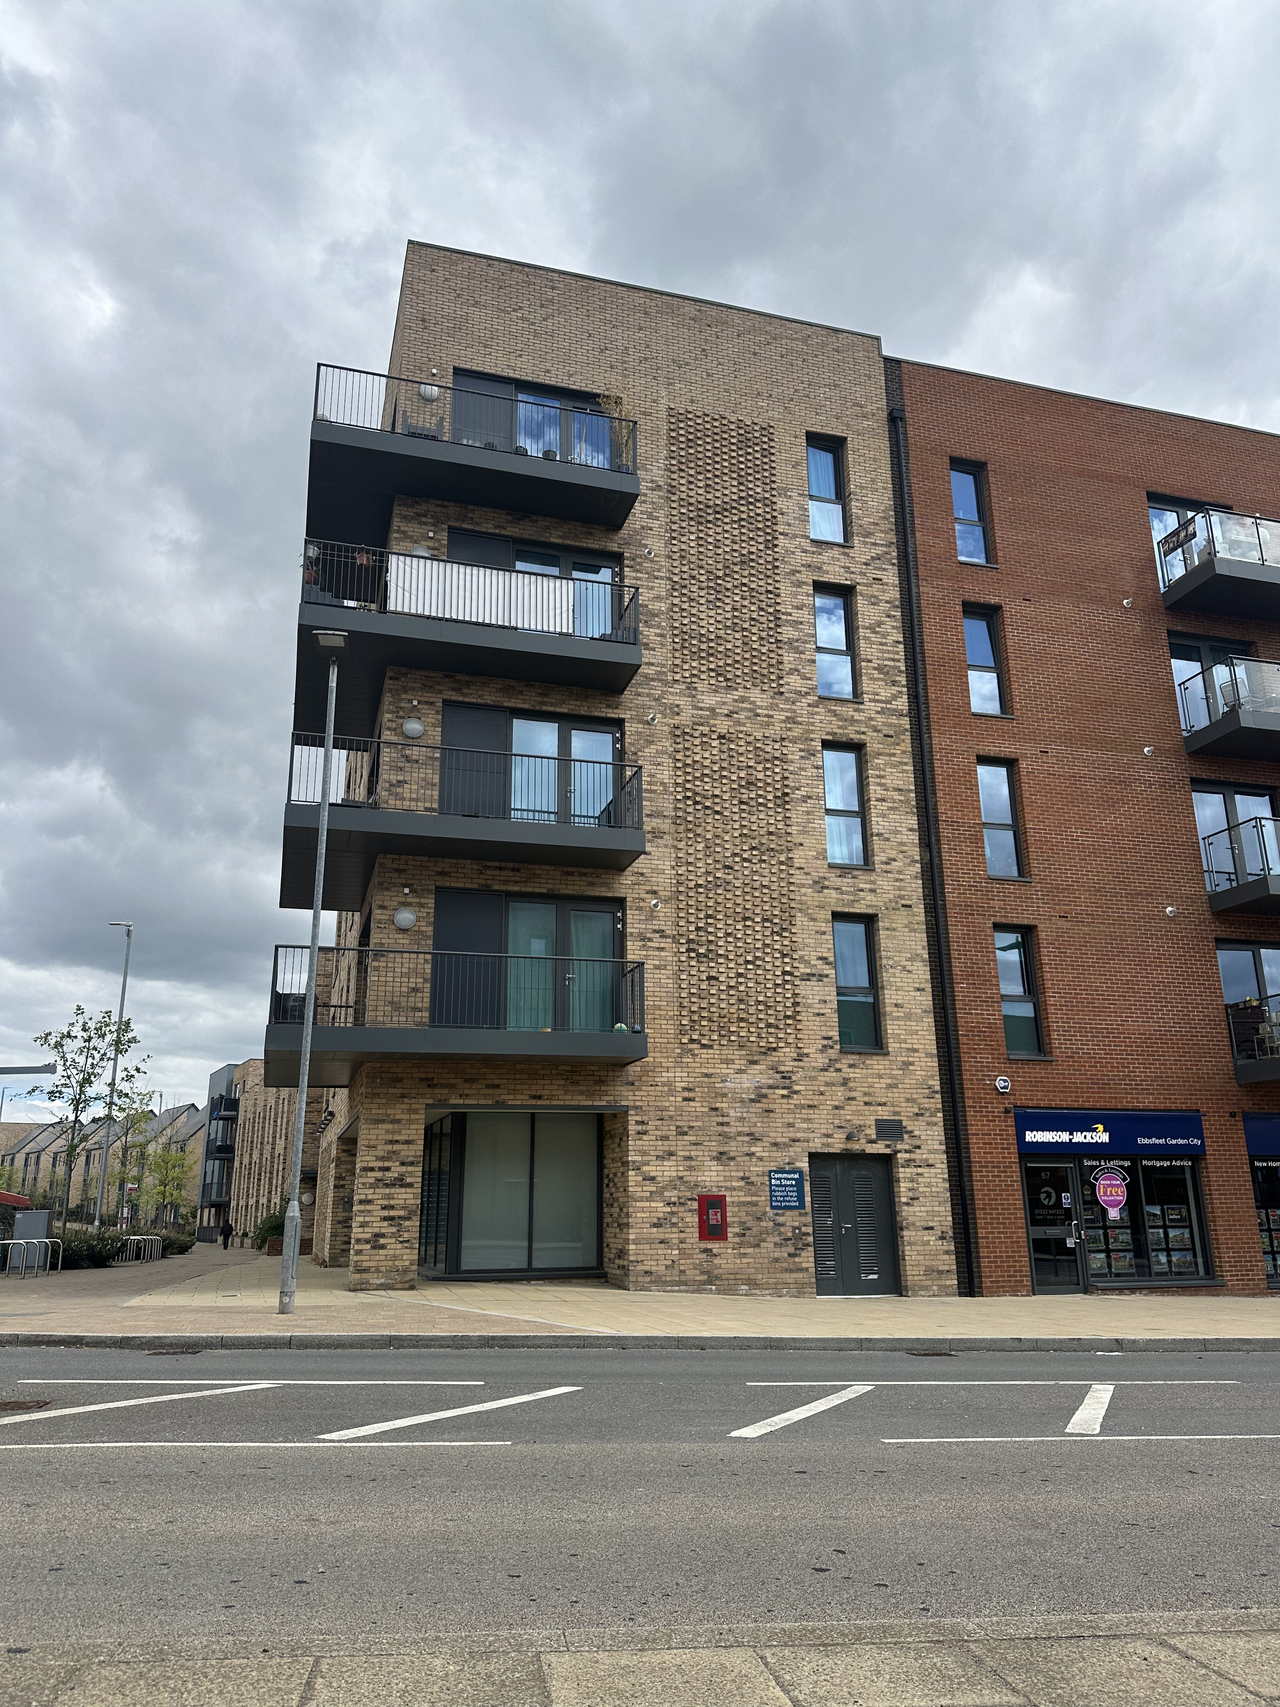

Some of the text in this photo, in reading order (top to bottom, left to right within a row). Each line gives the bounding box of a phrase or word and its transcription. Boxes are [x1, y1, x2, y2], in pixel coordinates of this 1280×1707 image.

[1025, 1130, 1110, 1143] ROBINSON-JACKSON
[1137, 1137, 1202, 1146] Ebbsfleet Garden City
[1106, 1159, 1131, 1167] Lettings
[1142, 1159, 1171, 1167] Mortgage
[1041, 1171, 1051, 1180] 67
[1100, 1184, 1124, 1196] Free
